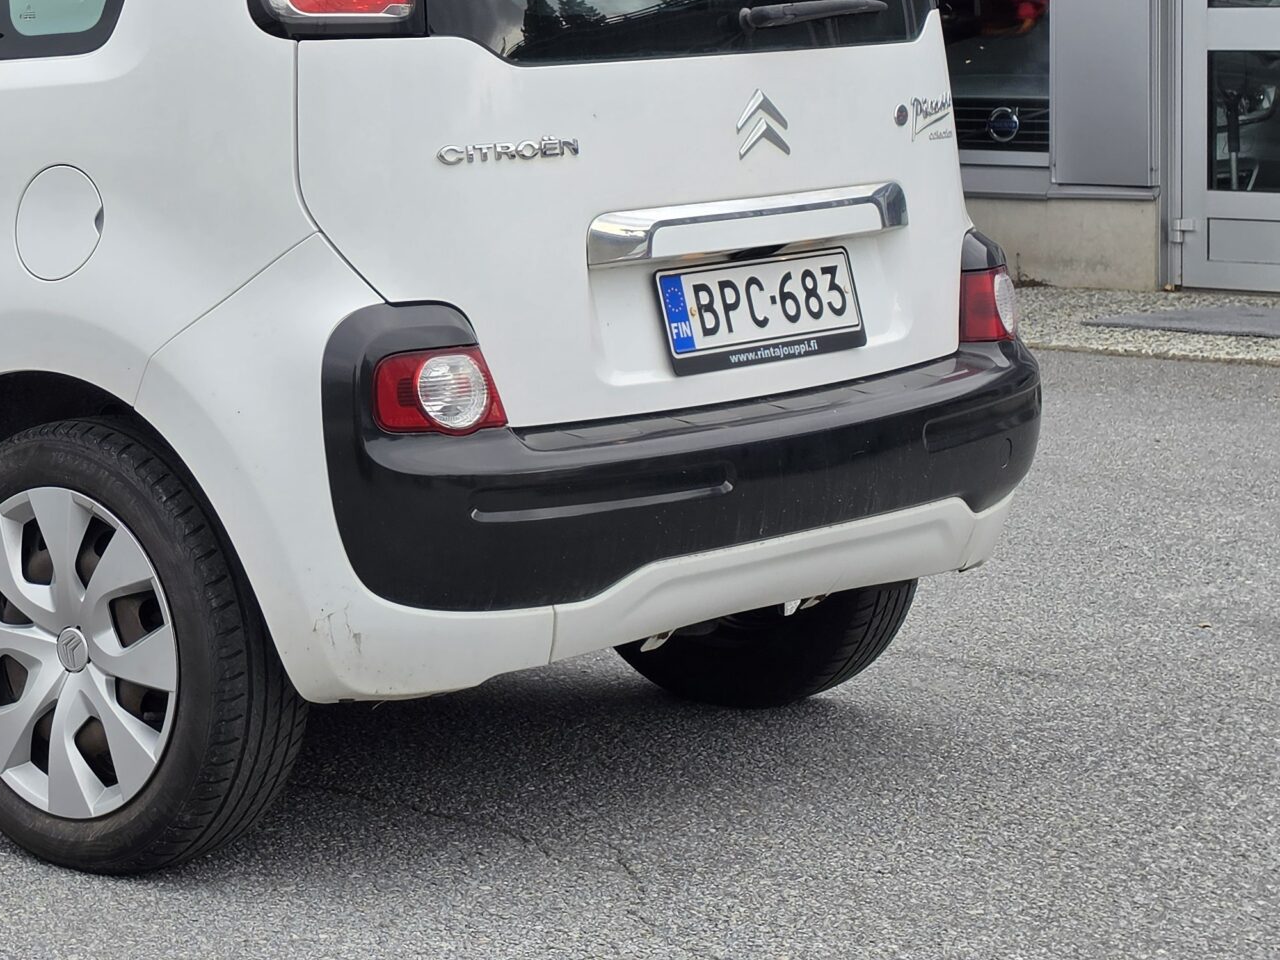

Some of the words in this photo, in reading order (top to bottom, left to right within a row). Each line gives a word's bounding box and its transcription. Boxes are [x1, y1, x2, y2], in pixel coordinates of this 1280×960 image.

[436, 134, 580, 166] CITROËN
[692, 264, 848, 338] BPC-683
[670, 321, 692, 340] FIN
[729, 339, 818, 364] www.rintajouppi.fi
